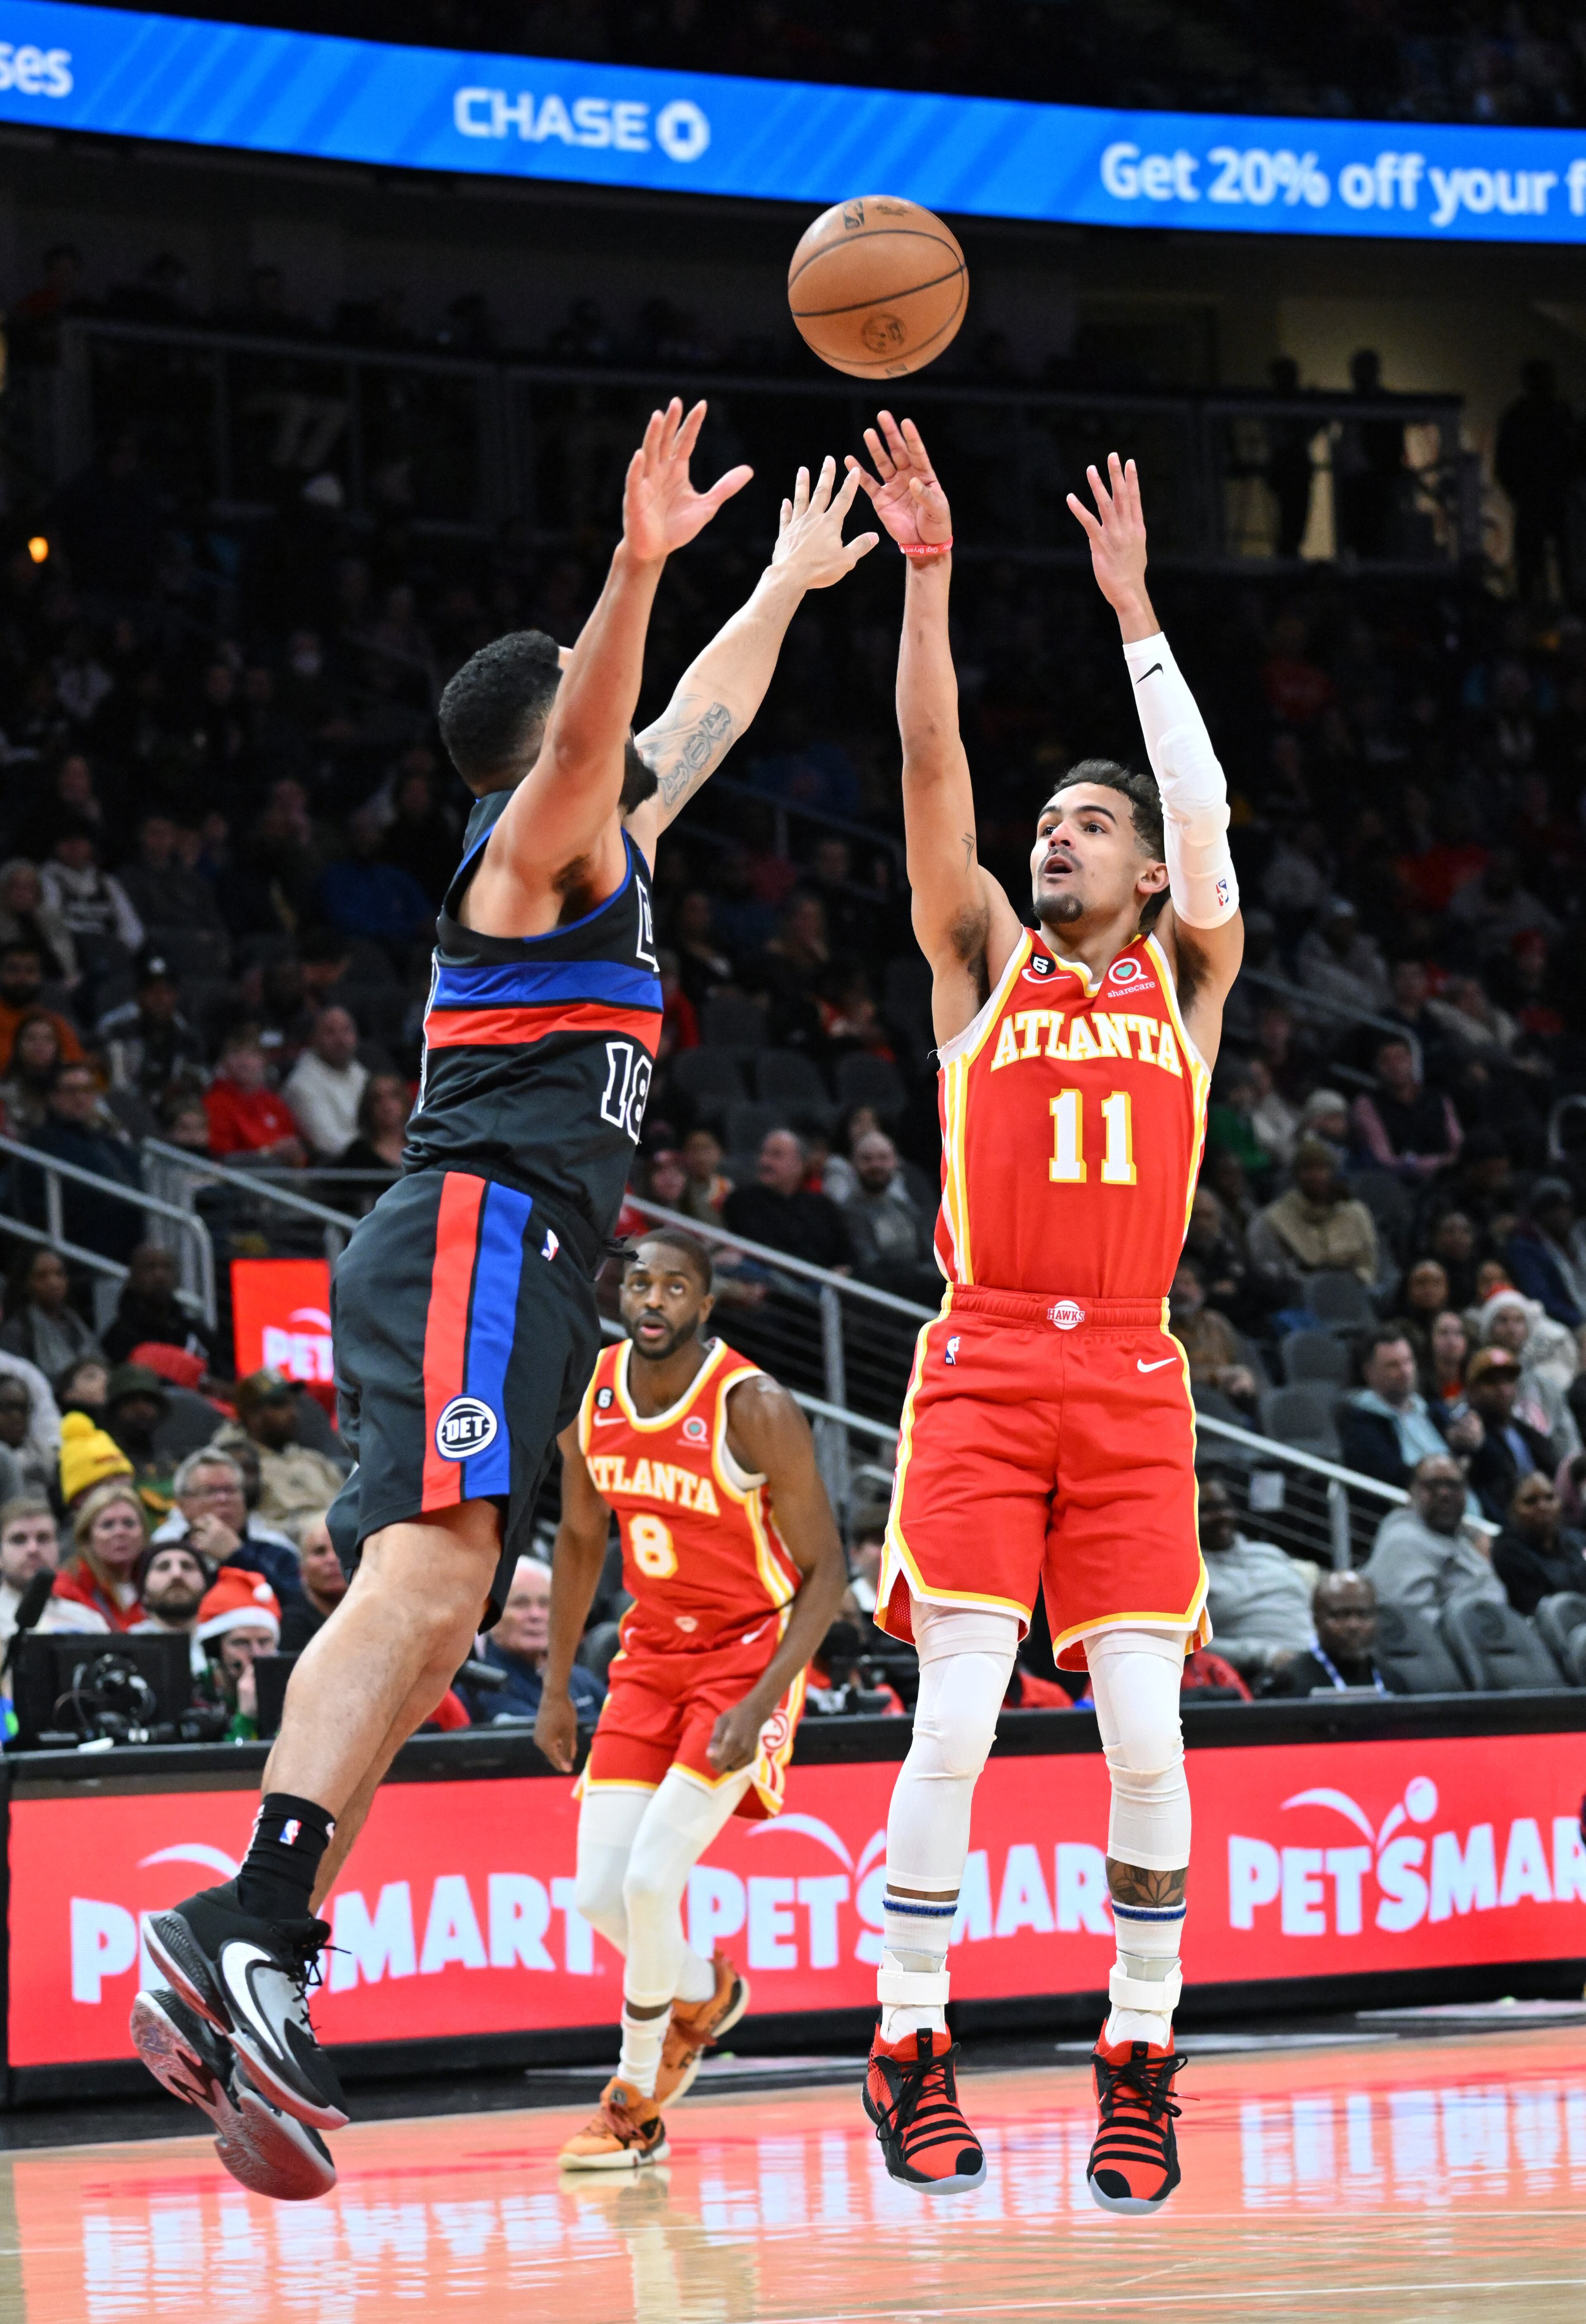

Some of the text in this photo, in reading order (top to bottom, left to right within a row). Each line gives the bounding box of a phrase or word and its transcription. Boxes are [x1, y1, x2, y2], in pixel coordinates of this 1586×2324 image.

[453, 86, 651, 153] CHASE
[1100, 141, 1200, 202] Get
[1207, 145, 1331, 208] 20%
[1339, 151, 1426, 211] off
[1428, 166, 1558, 227] your
[1033, 956, 1049, 974] 6
[1107, 981, 1156, 998] sharecare
[990, 1010, 1182, 1079] ATLANTA
[601, 1041, 653, 1145] 18
[1049, 1088, 1137, 1186] 11
[1047, 1308, 1085, 1322] HAWKS
[445, 1416, 485, 1442] DET
[597, 1388, 613, 1409] 6
[586, 1454, 720, 1518] TLANTA
[628, 1513, 679, 1579] 8
